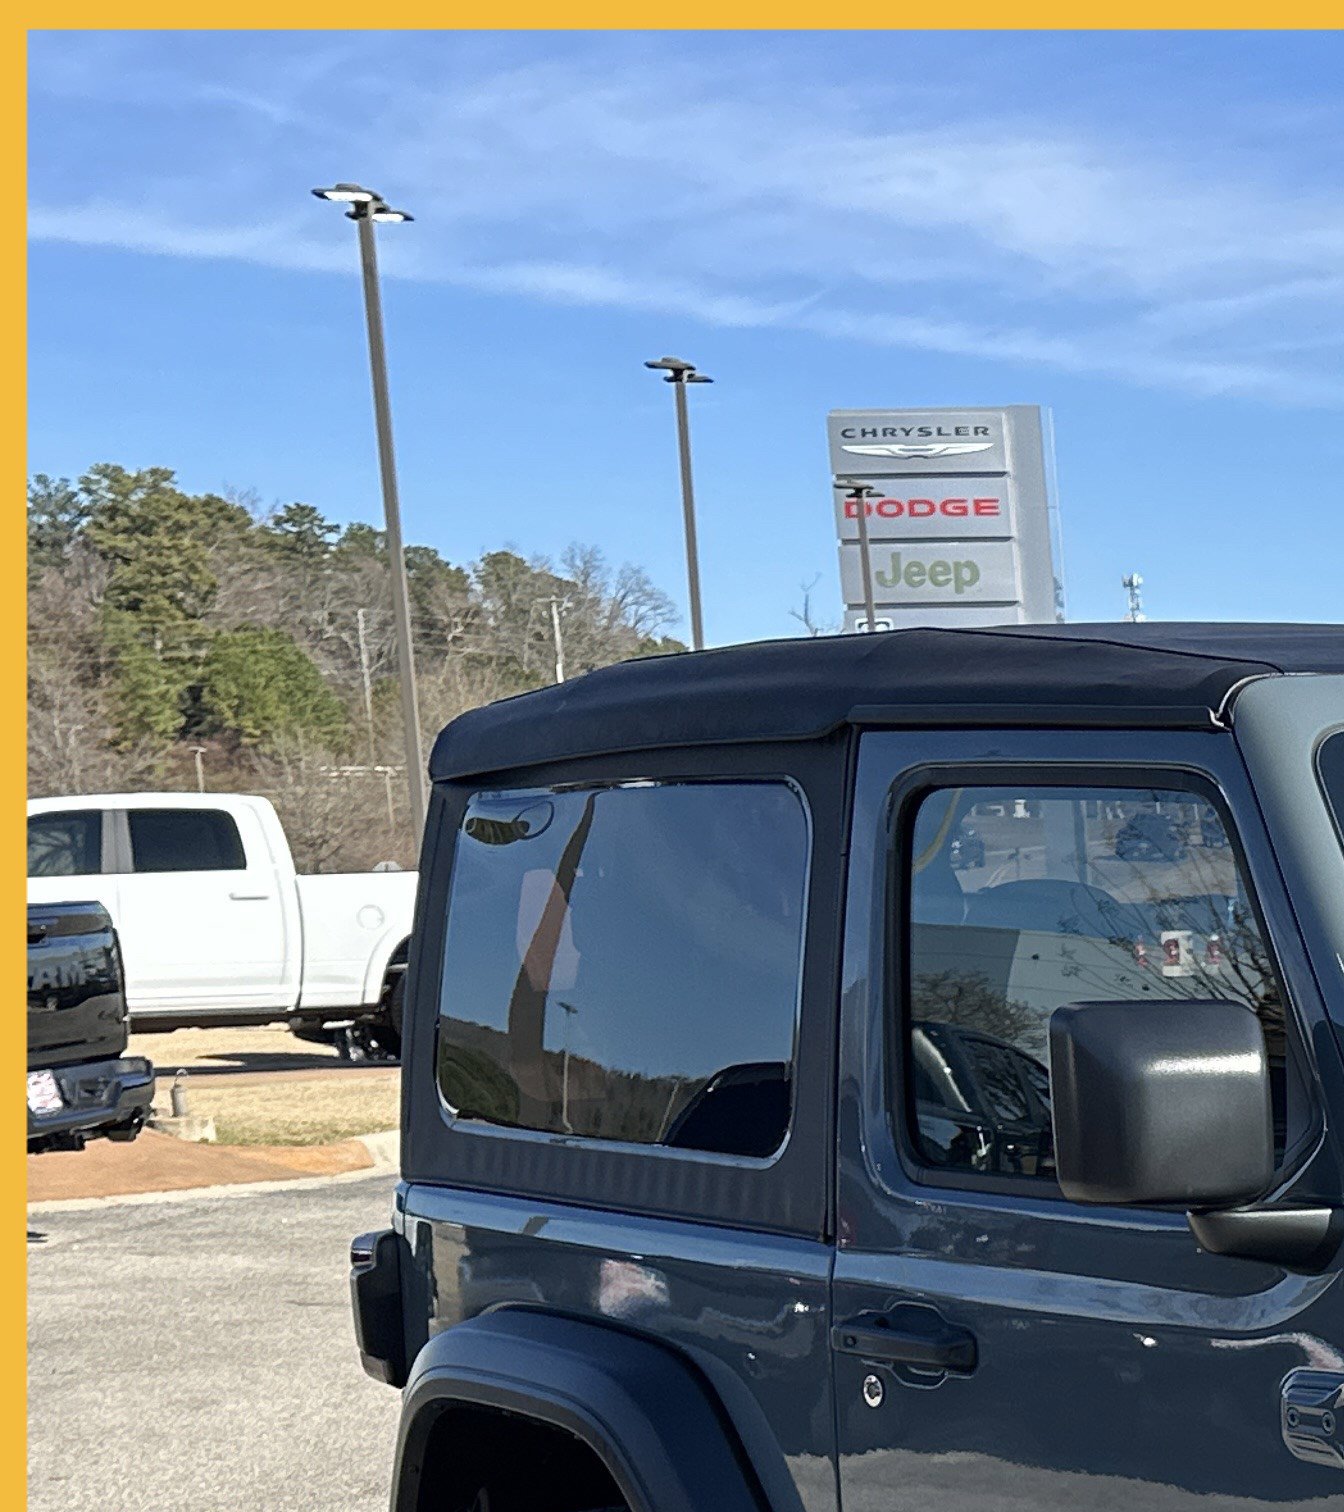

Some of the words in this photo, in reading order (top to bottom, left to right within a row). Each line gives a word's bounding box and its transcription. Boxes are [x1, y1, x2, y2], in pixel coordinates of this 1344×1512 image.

[841, 426, 990, 439] CHRYSLER
[844, 498, 1001, 519] DODGE
[875, 552, 980, 594] Jeep
